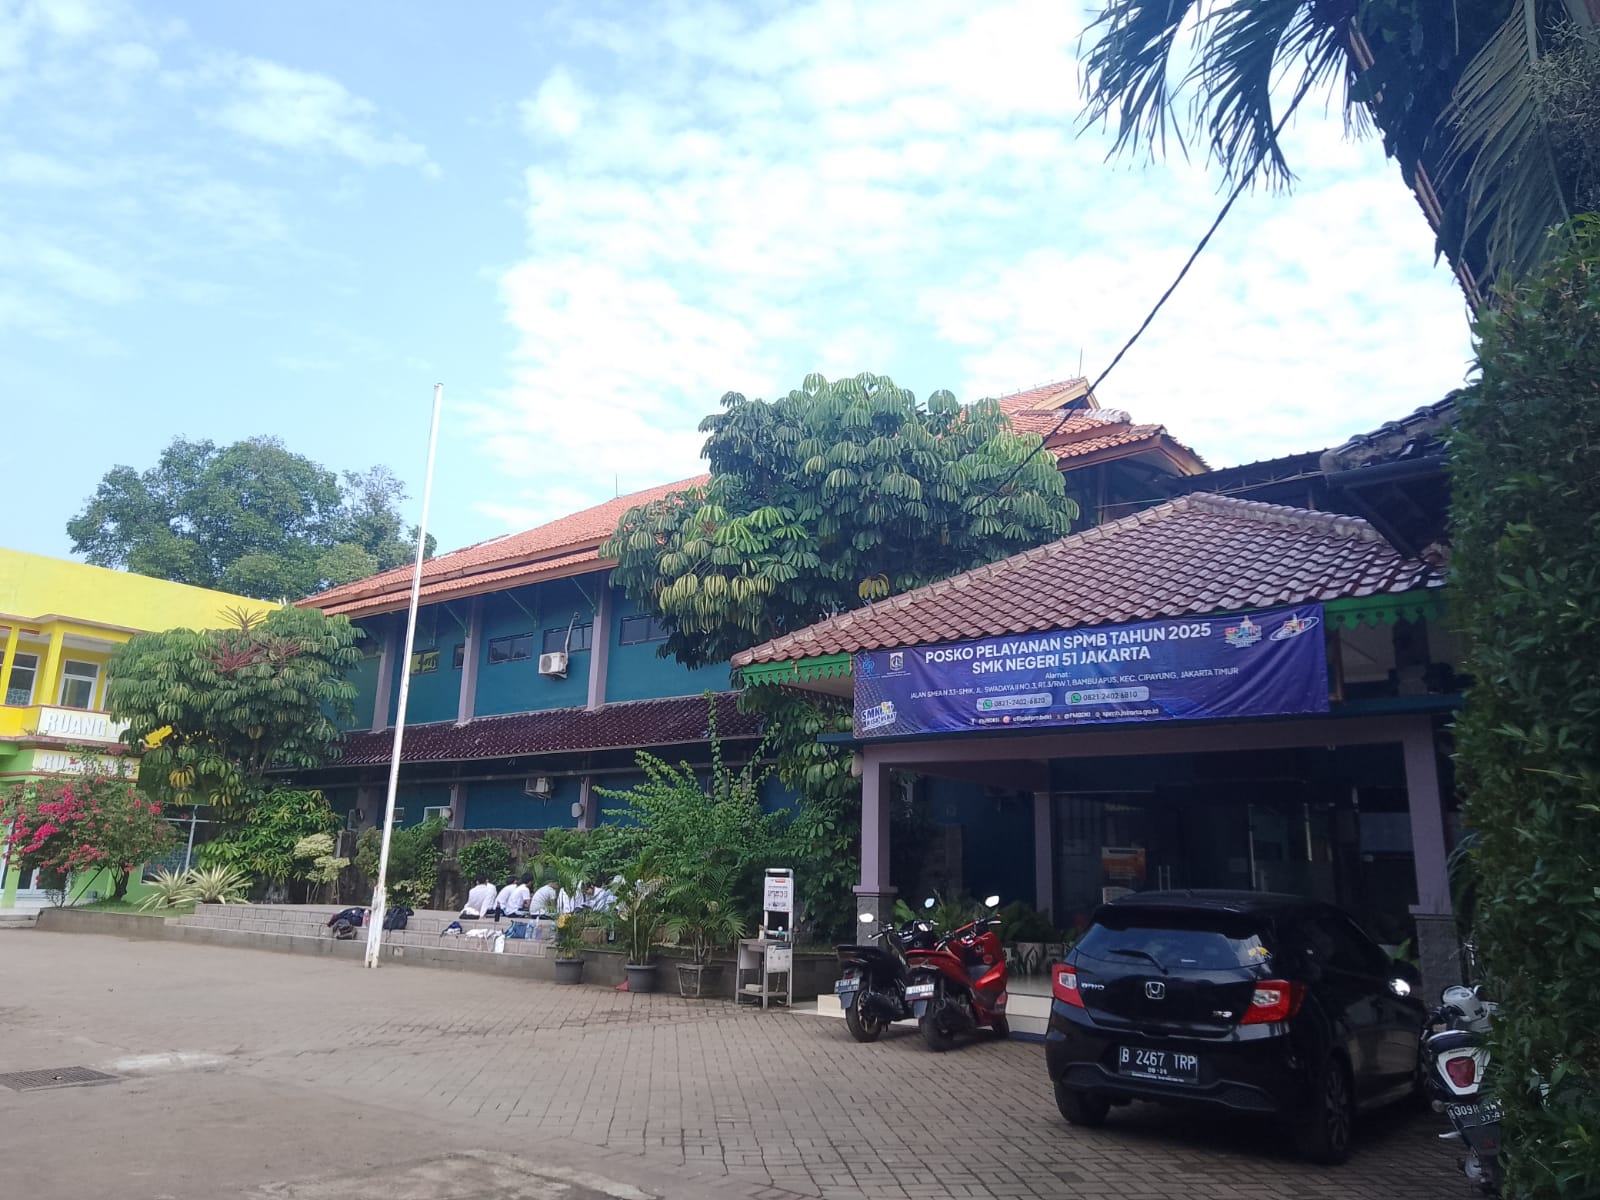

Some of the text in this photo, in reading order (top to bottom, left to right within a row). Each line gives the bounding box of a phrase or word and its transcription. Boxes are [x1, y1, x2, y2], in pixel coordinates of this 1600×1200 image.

[925, 622, 1212, 664] POSKO PELAYANAN SPMB TAHUN 2025
[972, 645, 1151, 675] SMK NEGERI 51 JAKARTA
[910, 690, 926, 699] JALAN
[984, 684, 1014, 693] SWADAYA
[1071, 677, 1098, 686] BAMBU
[1137, 671, 1178, 682] CIPAYUNG,
[1180, 669, 1213, 679] JAKARTA
[1213, 667, 1240, 677] TIMUR
[46, 712, 108, 737] RUANG
[1121, 1048, 1197, 1071] B 2467 TRP
